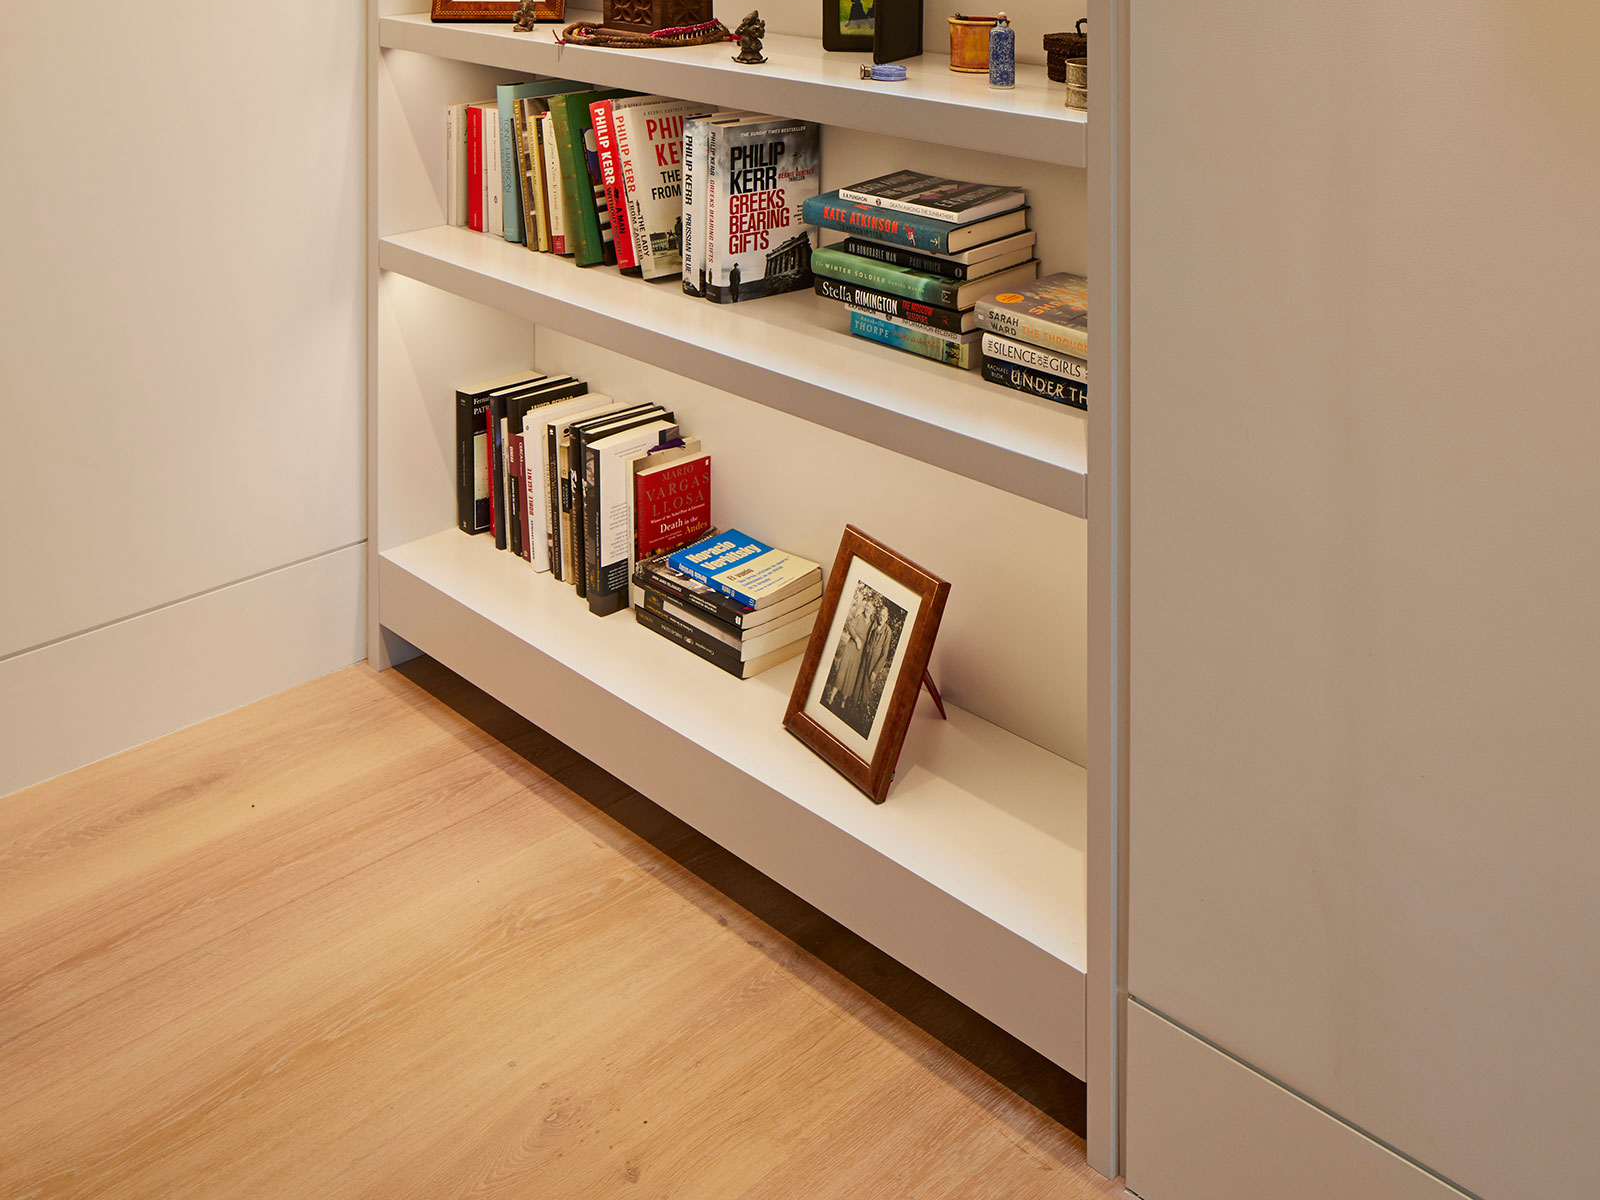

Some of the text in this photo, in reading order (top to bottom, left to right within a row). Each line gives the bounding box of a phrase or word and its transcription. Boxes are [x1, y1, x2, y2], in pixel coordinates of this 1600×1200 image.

[594, 107, 616, 185] PHILIP KERR
[615, 115, 636, 193] PHILIP KERR
[730, 142, 785, 170] PHILIP
[660, 170, 682, 184] THE
[685, 135, 694, 206] PHILIP KERR
[730, 166, 777, 195] KERR
[606, 188, 618, 222] WITHOUT
[651, 184, 682, 200] FROM
[729, 188, 785, 216] GREEKS
[616, 216, 626, 234] MAN
[629, 200, 638, 226] FROM
[729, 208, 790, 236] BEARING
[823, 206, 899, 235] KATE ATKINSON
[637, 216, 650, 257] THE LADY
[684, 213, 692, 274] PRUSSIAN BLUE
[728, 230, 770, 255] GIFTS
[848, 243, 897, 263] AN HONORABLE MAN
[909, 256, 922, 268] PAUL
[825, 263, 886, 284] WINTER SOLDIER
[822, 281, 898, 316] Stella RIMINGTON
[902, 300, 934, 316] THE MOSCOW
[854, 320, 890, 339] THORPE
[988, 310, 1019, 327] SARAH
[990, 322, 1017, 336] WARD
[1022, 325, 1040, 338] THE
[994, 341, 1036, 365] SILENCE
[1038, 355, 1043, 366] OF
[1049, 358, 1081, 377] GIRLS
[1010, 369, 1064, 398] UNDER
[662, 464, 694, 482] MARIO
[646, 472, 710, 502] VARGAS
[653, 489, 704, 516] LLOSA
[660, 518, 683, 534] Death
[685, 520, 708, 535] Andes
[685, 540, 737, 564] Horacio
[700, 543, 762, 571] Verbitsky
